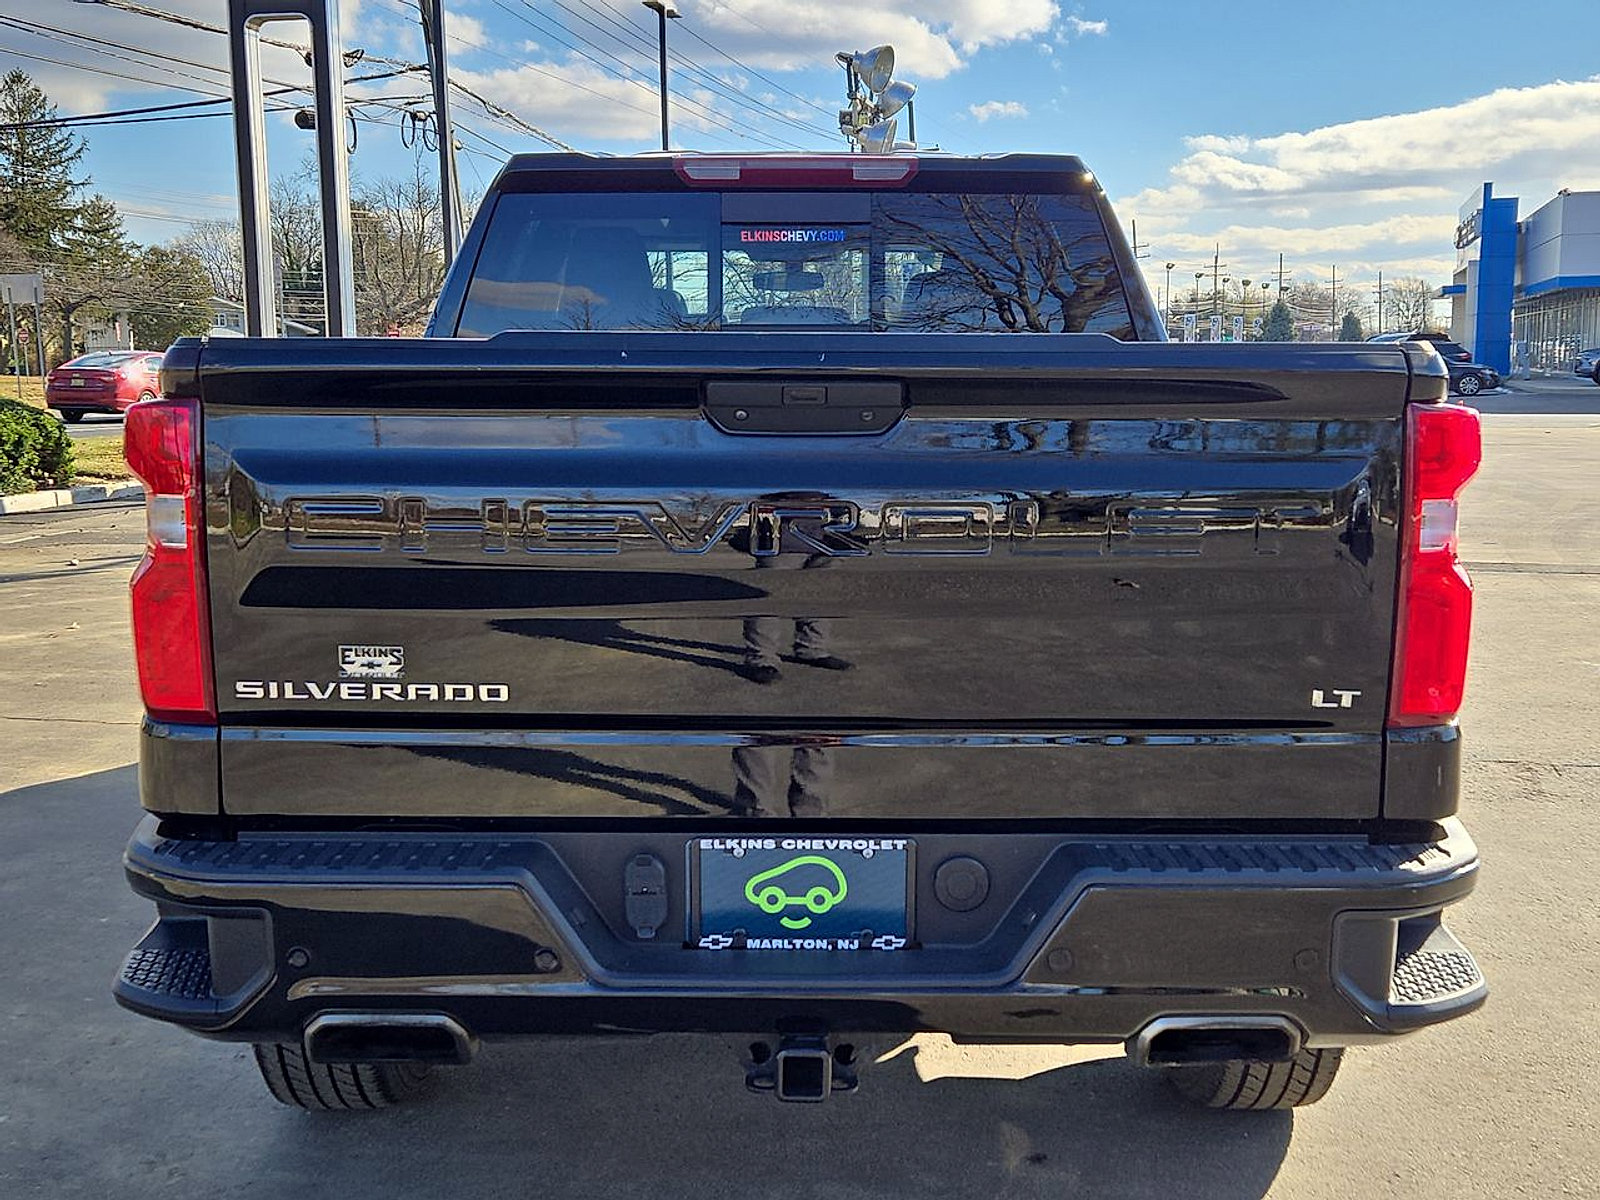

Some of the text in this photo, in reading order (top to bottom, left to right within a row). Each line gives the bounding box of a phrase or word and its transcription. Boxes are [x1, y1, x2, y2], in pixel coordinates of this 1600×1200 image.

[740, 229, 845, 242] ELKINSCHEVY.COM
[285, 498, 1318, 556] CHEVROLET
[340, 647, 403, 664] ELKINS
[235, 681, 509, 702] SILVERADO
[1311, 689, 1361, 708] LT
[700, 838, 908, 850] ELKINS CHEVROLET
[746, 938, 860, 950] MARLTON, NJ
